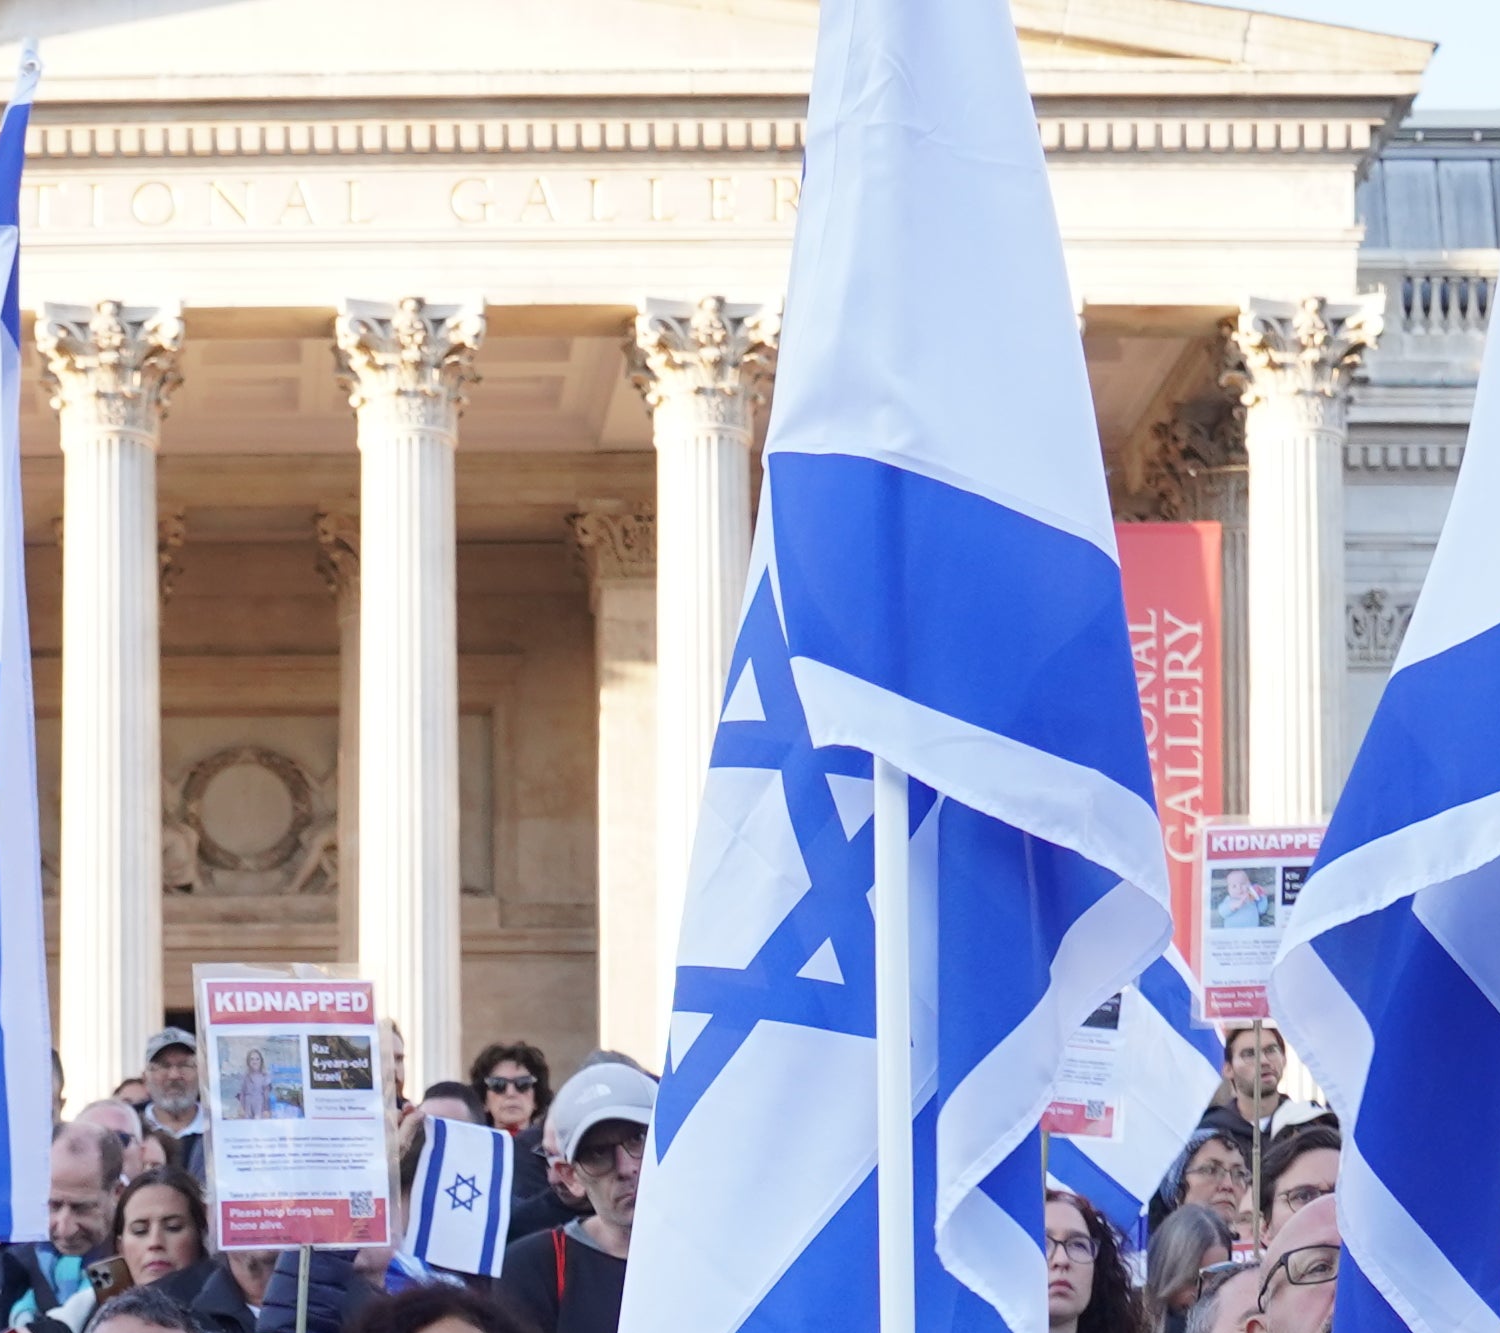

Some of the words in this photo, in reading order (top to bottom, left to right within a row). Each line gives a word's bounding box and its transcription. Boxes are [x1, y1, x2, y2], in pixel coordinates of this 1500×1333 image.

[1164, 608, 1204, 864] GALLERY
[214, 991, 369, 1013] KIDNAPPED
[311, 1044, 330, 1054] Raz
